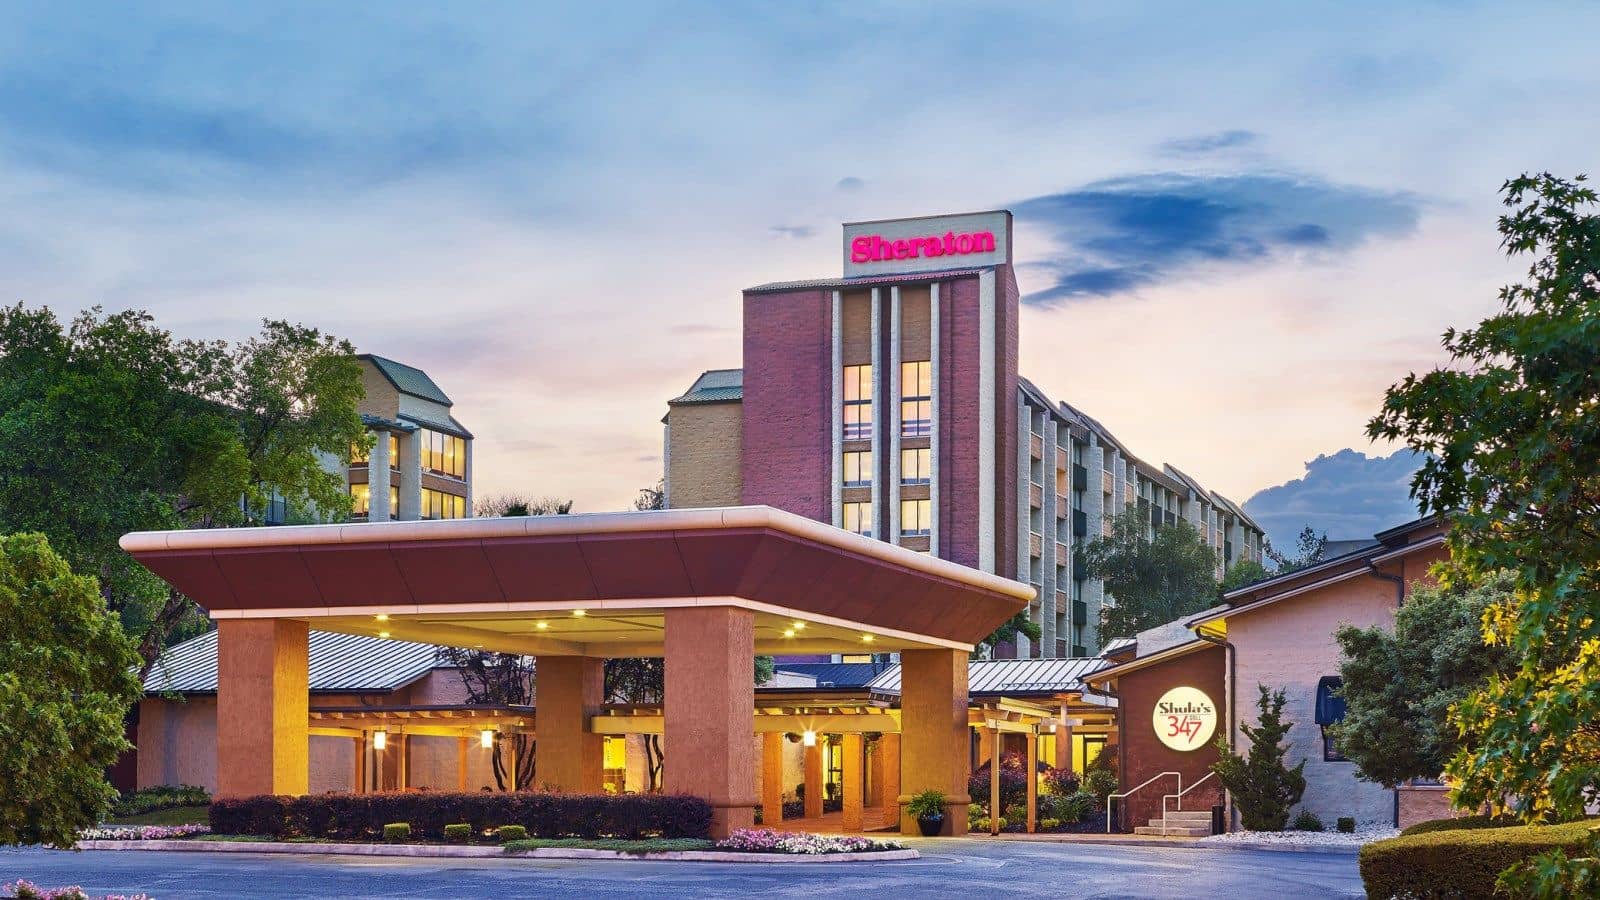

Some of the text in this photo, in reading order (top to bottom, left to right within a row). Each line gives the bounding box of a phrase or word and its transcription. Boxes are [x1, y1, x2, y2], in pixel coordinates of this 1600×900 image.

[851, 231, 995, 263] Sheraton
[1158, 702, 1211, 713] Shula's
[1167, 715, 1202, 744] 347
